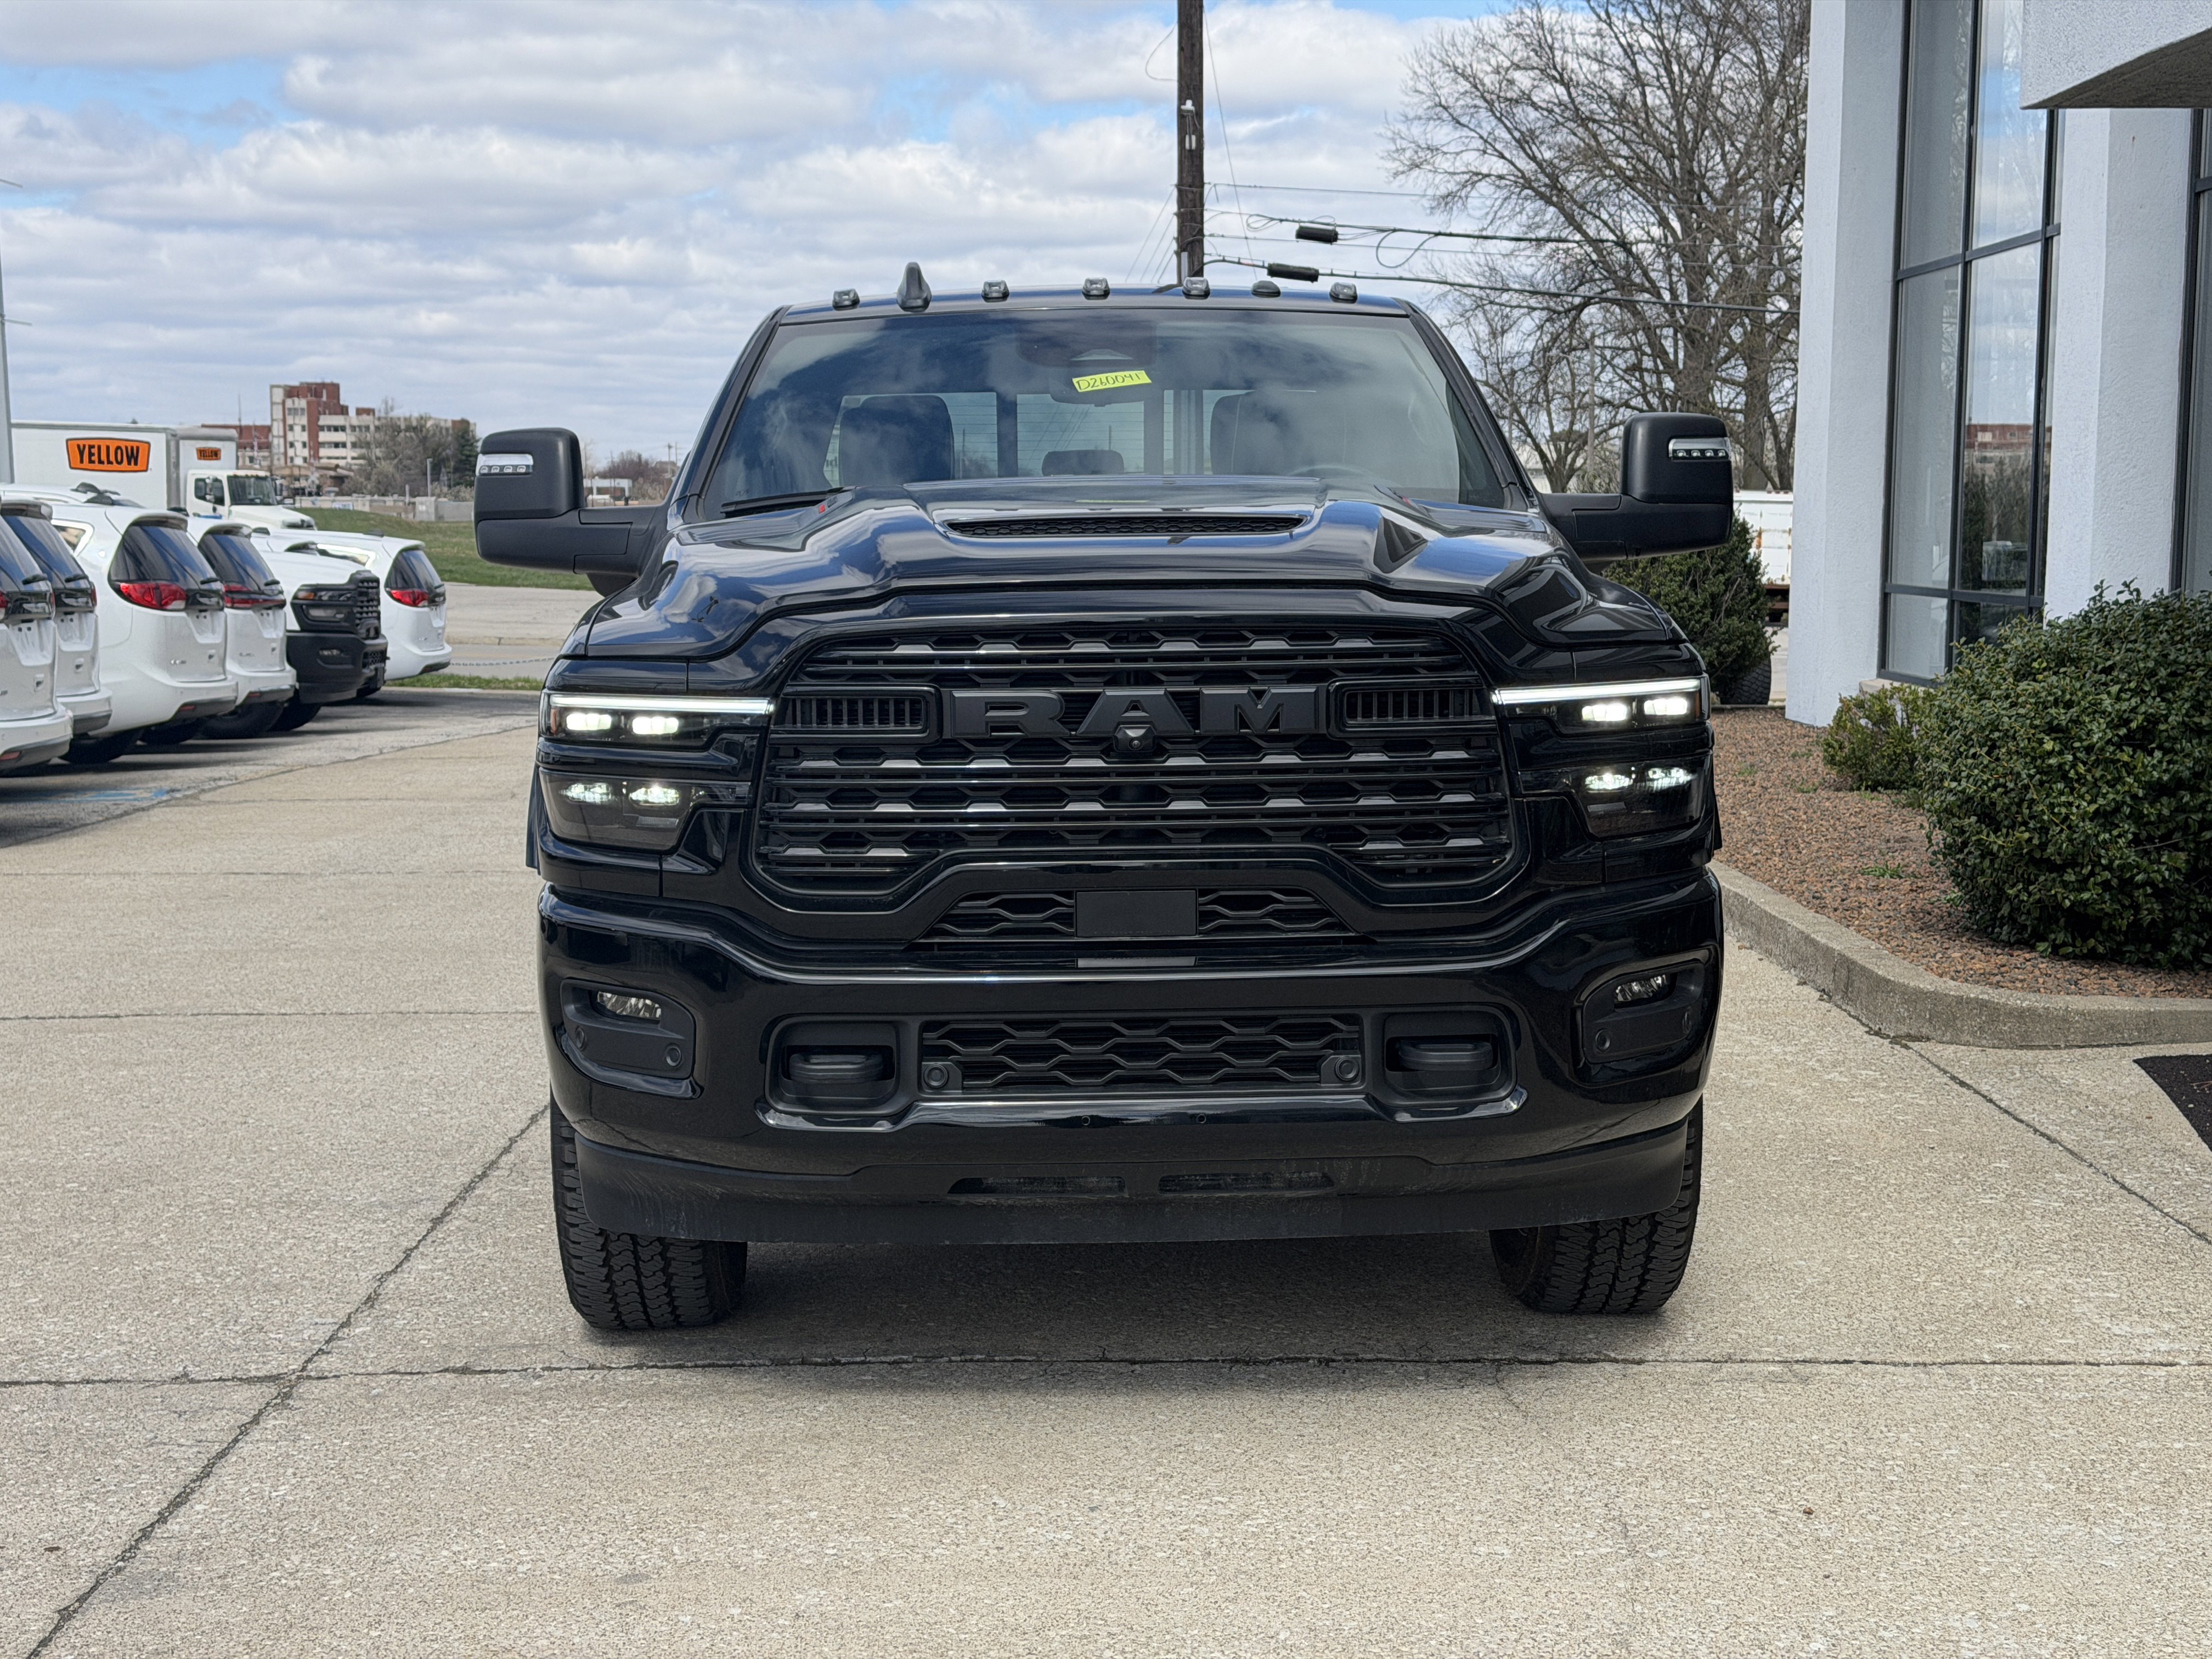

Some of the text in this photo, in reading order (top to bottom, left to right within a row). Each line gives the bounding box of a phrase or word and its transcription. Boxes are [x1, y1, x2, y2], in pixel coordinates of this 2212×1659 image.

[1076, 373, 1141, 390] D260041
[77, 444, 140, 466] YELLOW
[951, 690, 1318, 737] RAM
